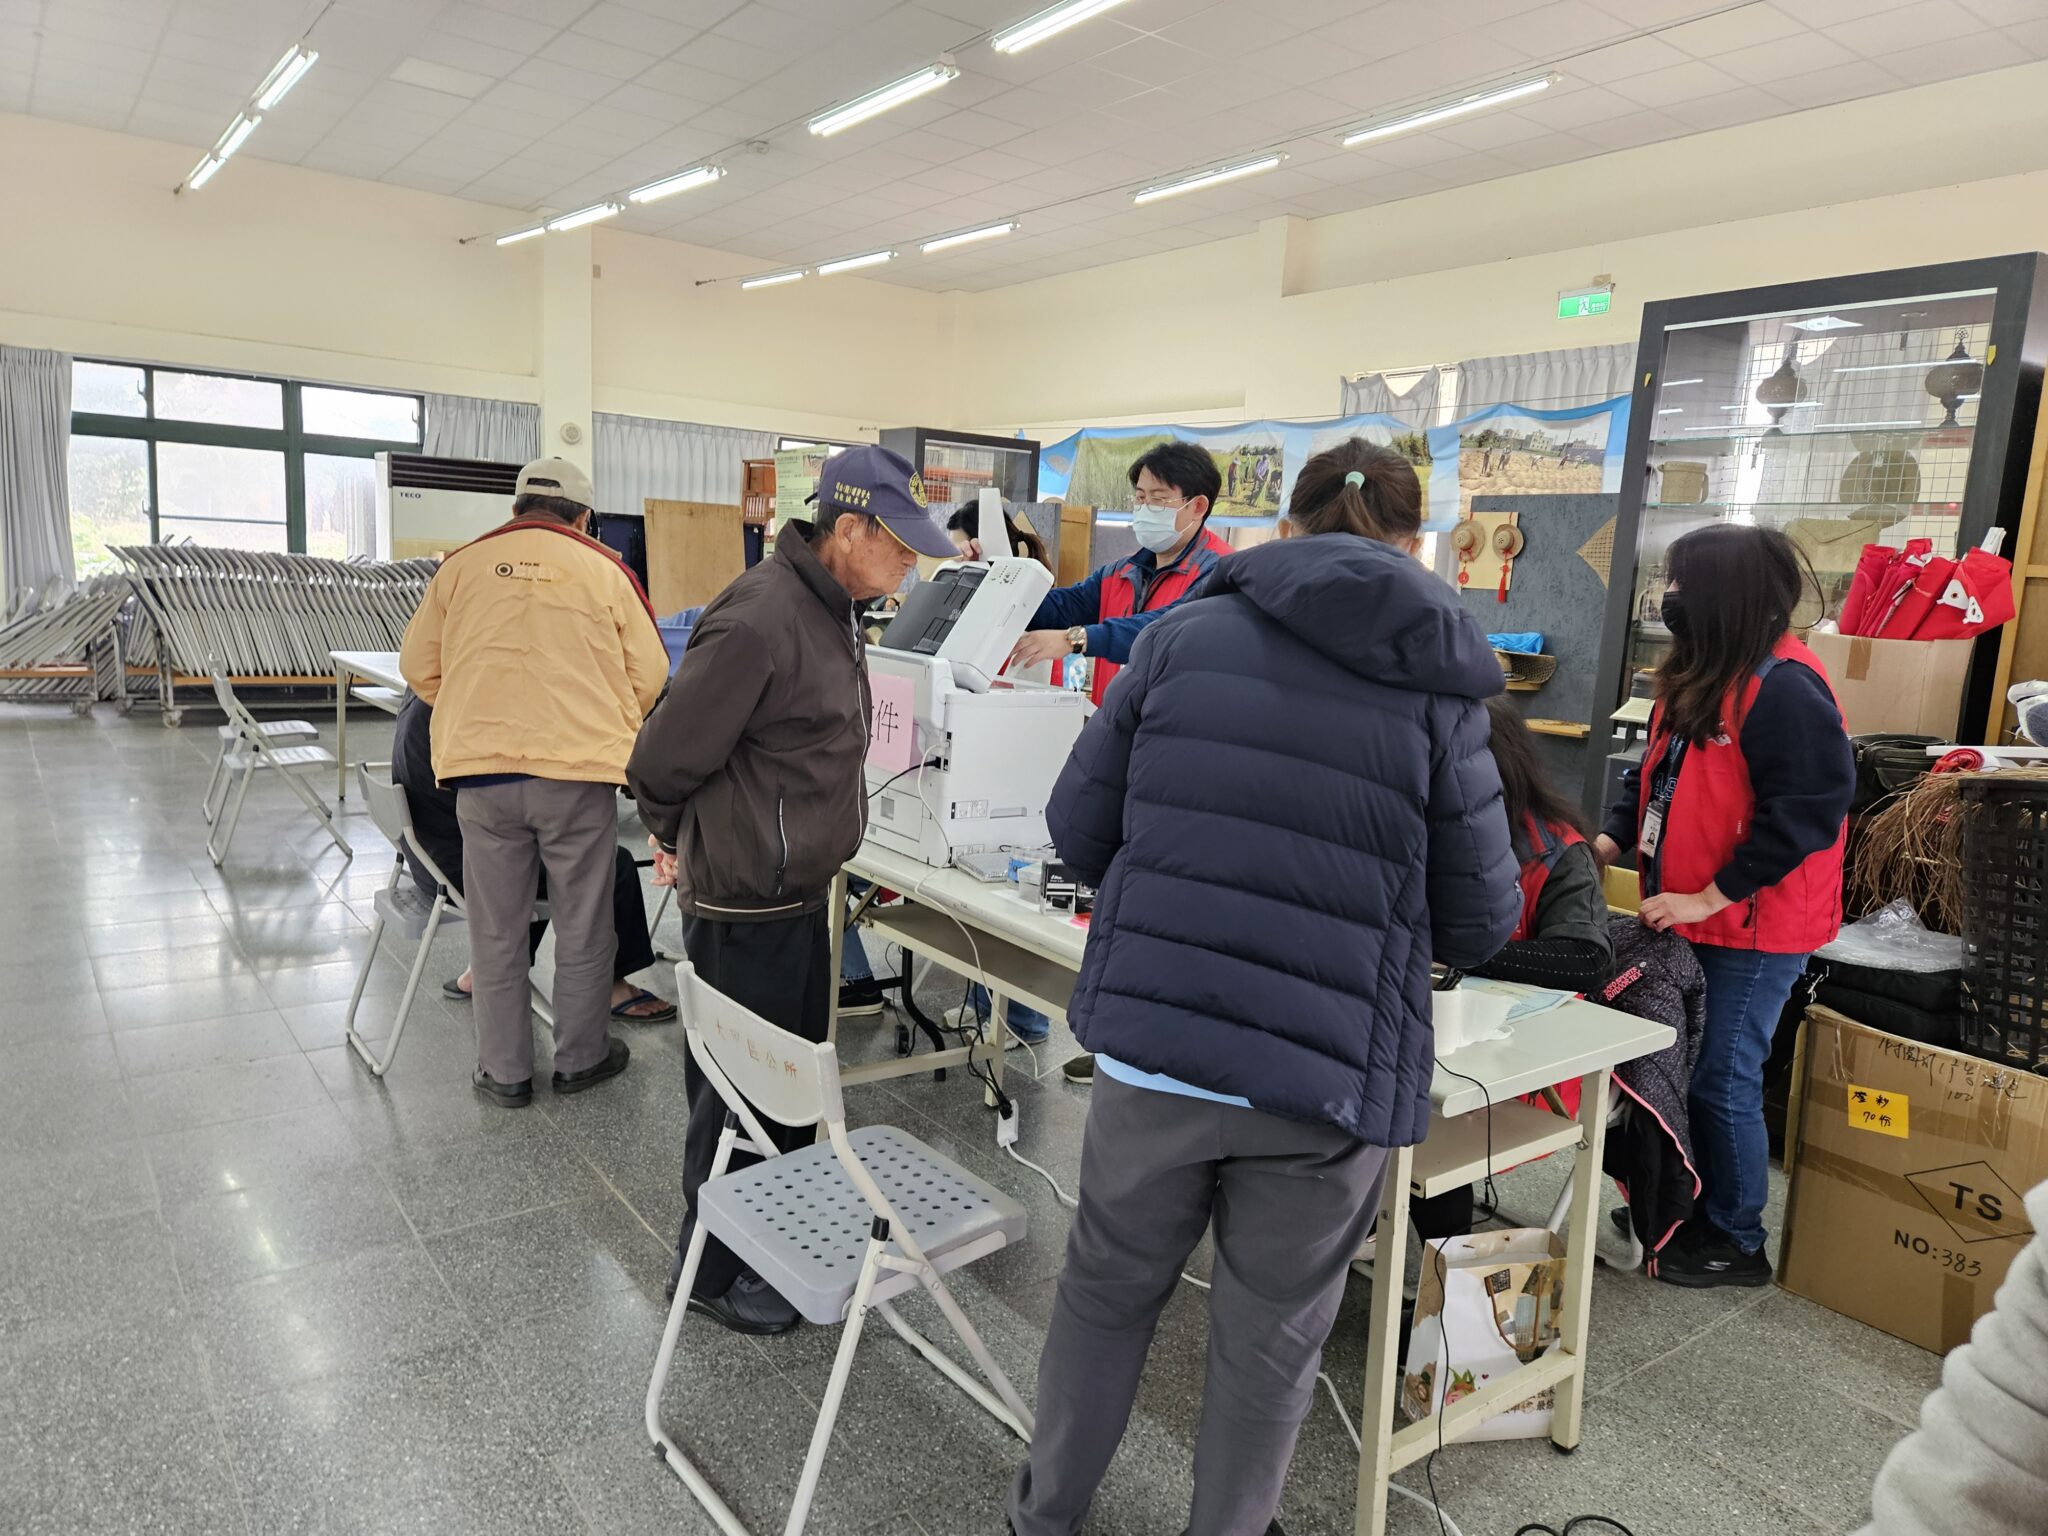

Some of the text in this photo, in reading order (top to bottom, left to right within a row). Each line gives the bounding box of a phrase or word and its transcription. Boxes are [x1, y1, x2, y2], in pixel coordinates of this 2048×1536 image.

[400, 491, 422, 499] TECO
[871, 699, 898, 744] 件
[1606, 978, 1632, 1000] OUTDOOR
[1949, 1181, 2003, 1222] TS
